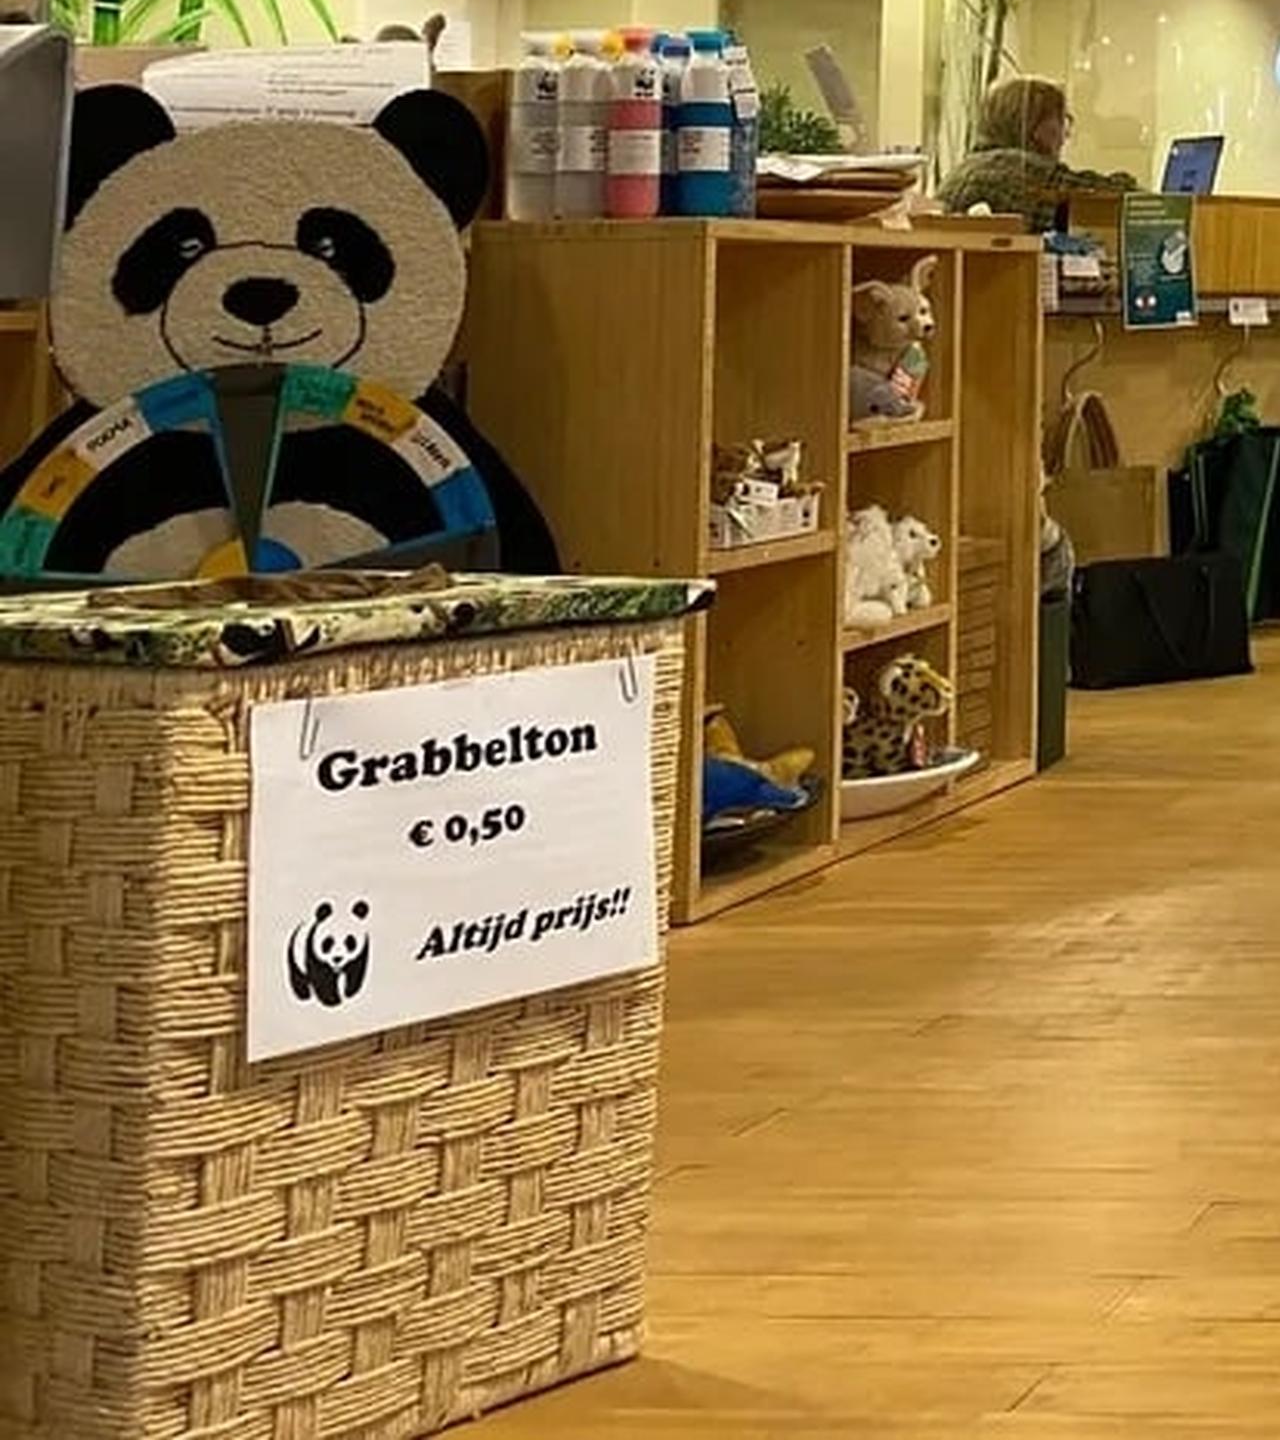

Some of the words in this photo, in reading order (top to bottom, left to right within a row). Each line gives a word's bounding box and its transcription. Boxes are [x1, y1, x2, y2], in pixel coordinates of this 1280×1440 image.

[316, 722, 598, 793] Grabbelton
[408, 819, 435, 848] €
[443, 803, 526, 847] 0,50
[415, 908, 529, 961] Altijd
[529, 886, 632, 944] prijs!!
